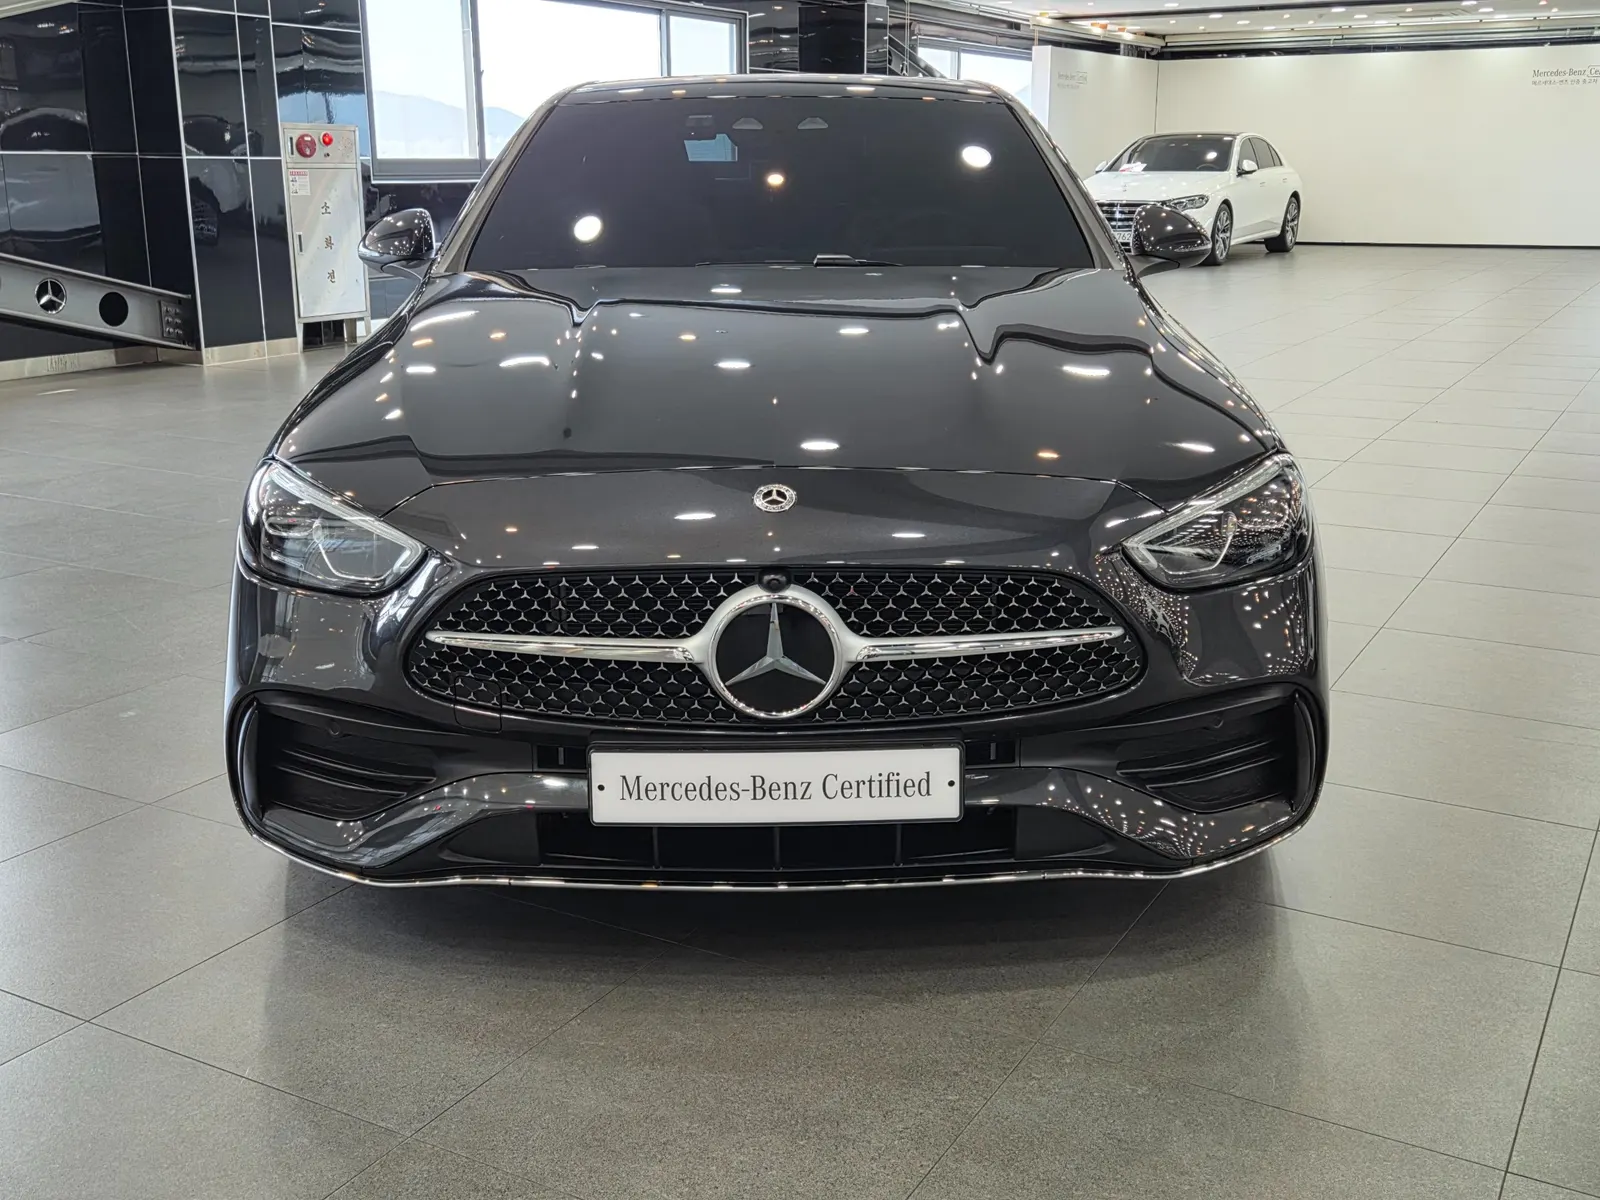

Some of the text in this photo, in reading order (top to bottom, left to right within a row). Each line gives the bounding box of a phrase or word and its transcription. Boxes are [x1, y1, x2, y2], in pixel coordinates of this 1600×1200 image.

[1532, 68, 1586, 77] Mercedes-Benz
[619, 771, 932, 802] Mercedes-Benz Certified
